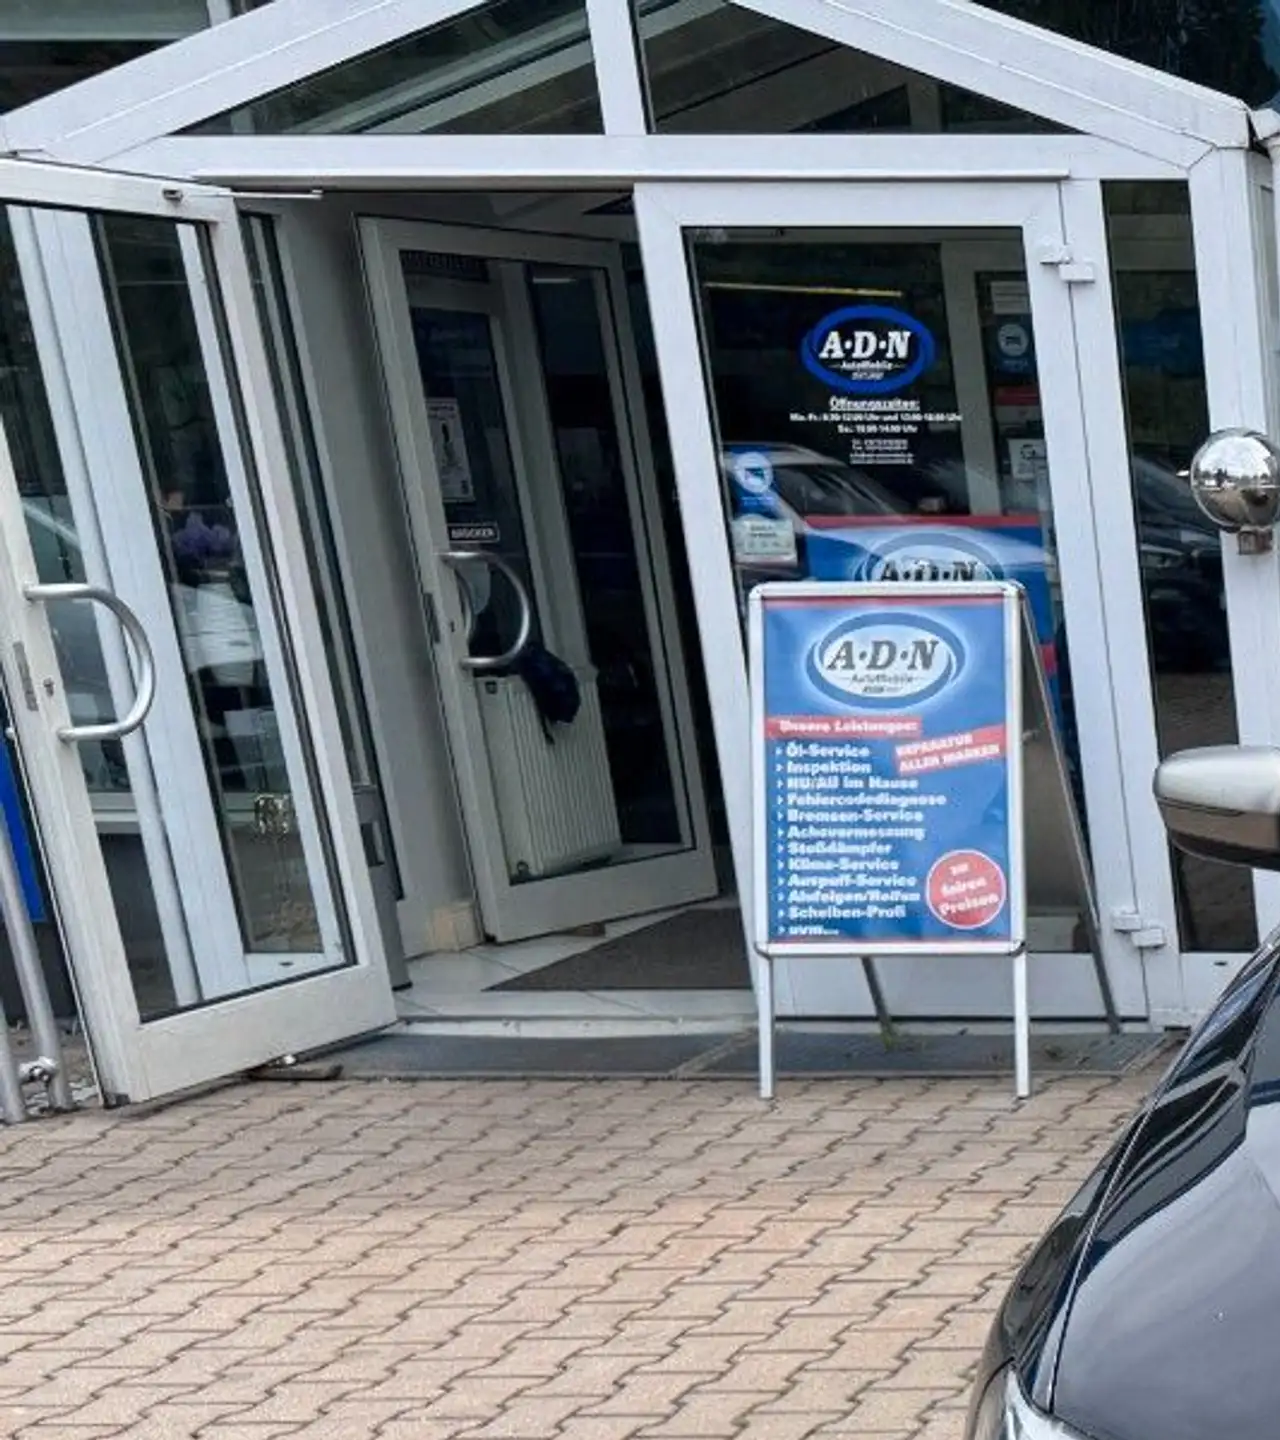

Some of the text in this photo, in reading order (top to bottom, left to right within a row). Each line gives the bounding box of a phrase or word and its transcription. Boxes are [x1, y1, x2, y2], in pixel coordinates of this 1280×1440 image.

[819, 331, 912, 359] A·D·N
[830, 396, 920, 411] Öffnungszeiten:
[826, 640, 939, 670] A·D·N
[779, 720, 918, 735] Unsere Leistungen:
[785, 742, 870, 757] Öl-Service
[895, 732, 974, 756] REPARATUR
[900, 743, 1000, 772] ALLER MARKEN
[786, 762, 872, 776] Inspektion
[843, 776, 864, 789] im
[868, 776, 919, 789] Hause
[787, 792, 947, 808] Fehlercodediagnose
[787, 808, 924, 822] Bremsen-Service
[787, 825, 926, 841] Achsvermessung
[787, 842, 892, 857] Stoßdämpfer
[788, 857, 899, 870] Klima-Service
[788, 873, 917, 888] Auspuff-Service
[788, 889, 921, 905] Alufelgen/Reifen
[939, 893, 999, 916] Preisen
[788, 905, 907, 919] Scheiben-Profi
